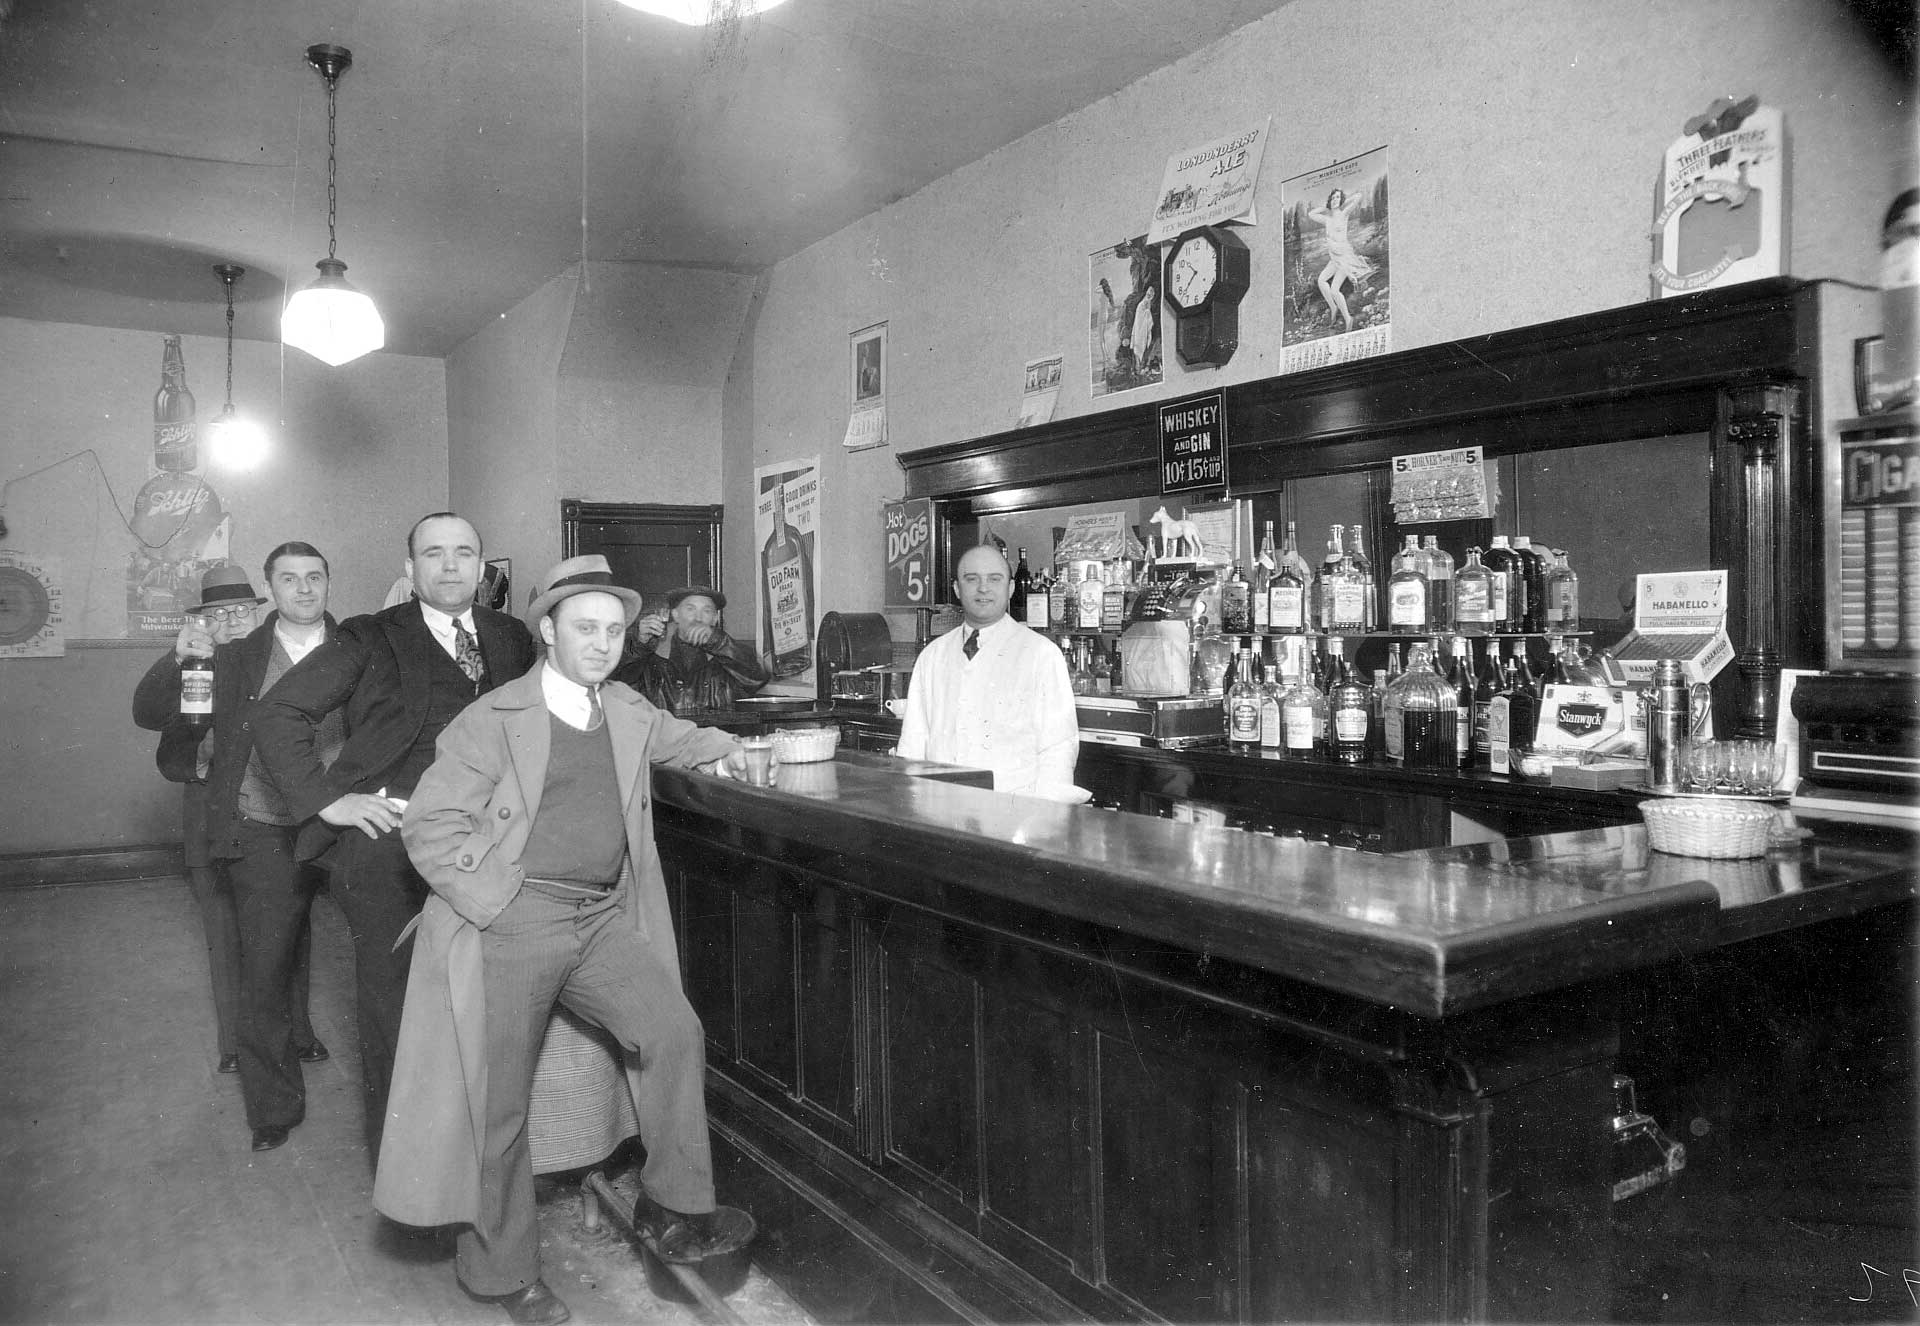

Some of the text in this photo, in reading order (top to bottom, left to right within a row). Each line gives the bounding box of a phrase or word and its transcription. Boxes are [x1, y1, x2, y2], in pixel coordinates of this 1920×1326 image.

[1177, 129, 1259, 171] LONDONDERRY
[1677, 145, 1710, 167] THREE
[1210, 150, 1246, 178] ALE
[1185, 247, 1191, 256] 11
[1193, 240, 1200, 250] 12
[1178, 259, 1186, 268] 10
[1164, 405, 1218, 433] WHISKEY
[1174, 432, 1211, 453] AND GIN
[1209, 462, 1221, 478] UP
[785, 480, 817, 503] GOOD DRINKS
[759, 500, 772, 515] THREE
[798, 510, 810, 525] TWO
[885, 511, 904, 529] Hot
[888, 516, 928, 564] DOGS
[771, 567, 800, 589] OLD FARM
[1652, 600, 1709, 610] HABANELLO
[141, 623, 185, 631] Milwauke
[143, 616, 157, 624] The
[161, 616, 181, 624] Beer
[1701, 640, 1727, 668] HABANELLO
[1559, 709, 1602, 729] Stanwyck
